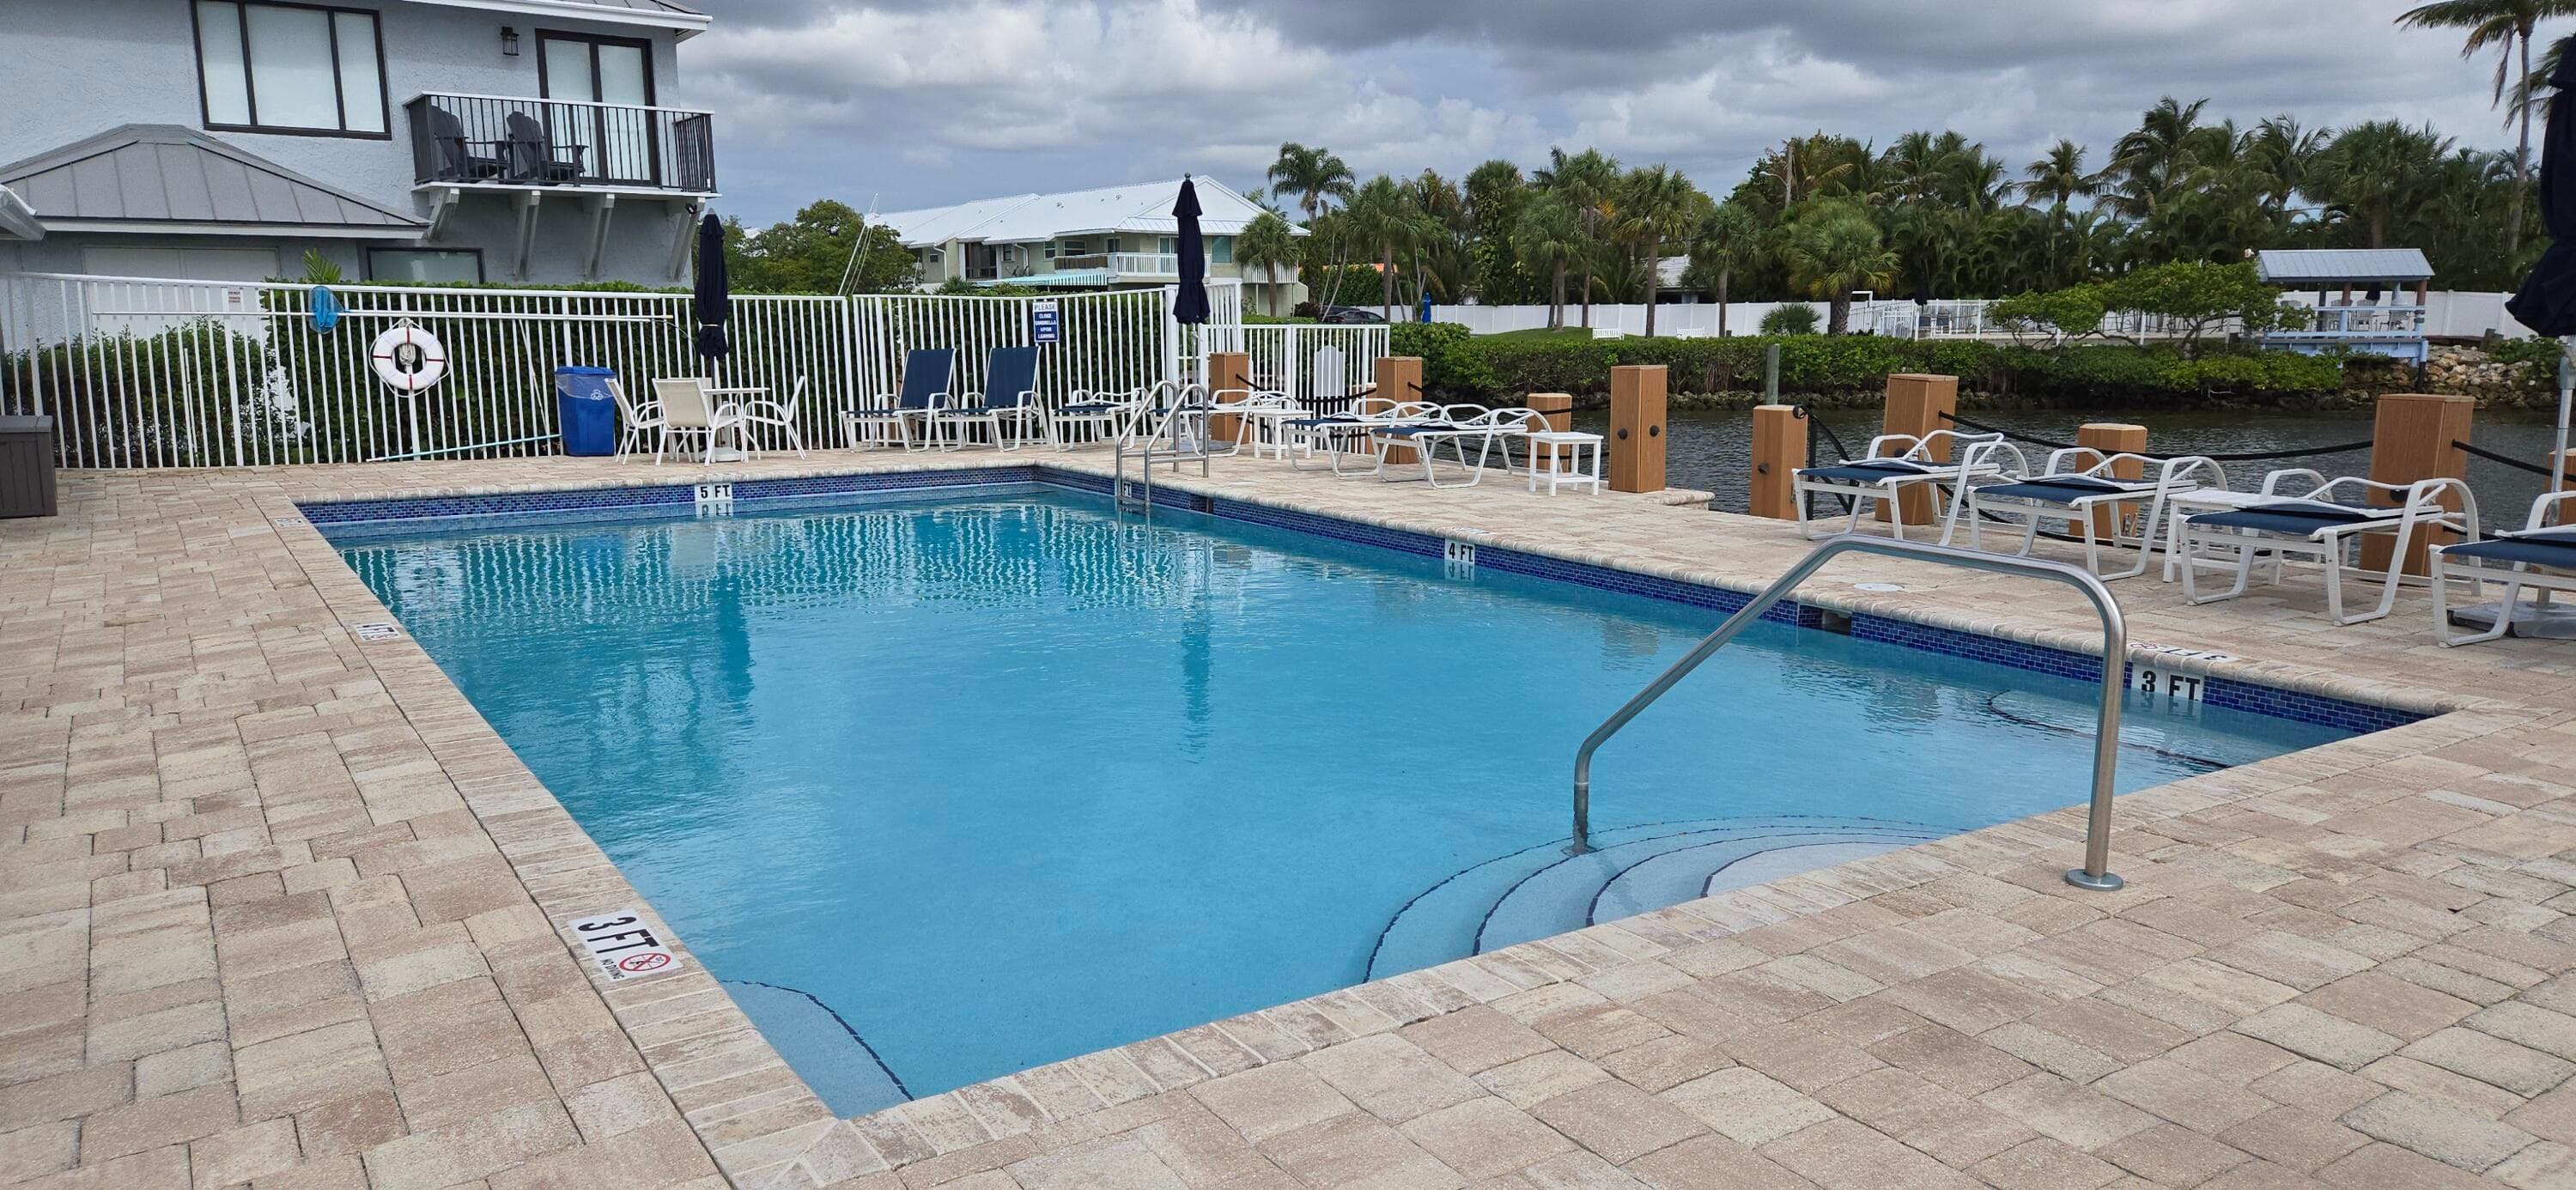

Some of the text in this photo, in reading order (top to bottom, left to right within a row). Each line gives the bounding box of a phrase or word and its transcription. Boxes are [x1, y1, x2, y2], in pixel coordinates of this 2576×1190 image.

[700, 486, 708, 499] 5
[1449, 542, 1455, 559] 4
[2142, 670, 2156, 692] 3
[578, 916, 660, 954] 3 FT
